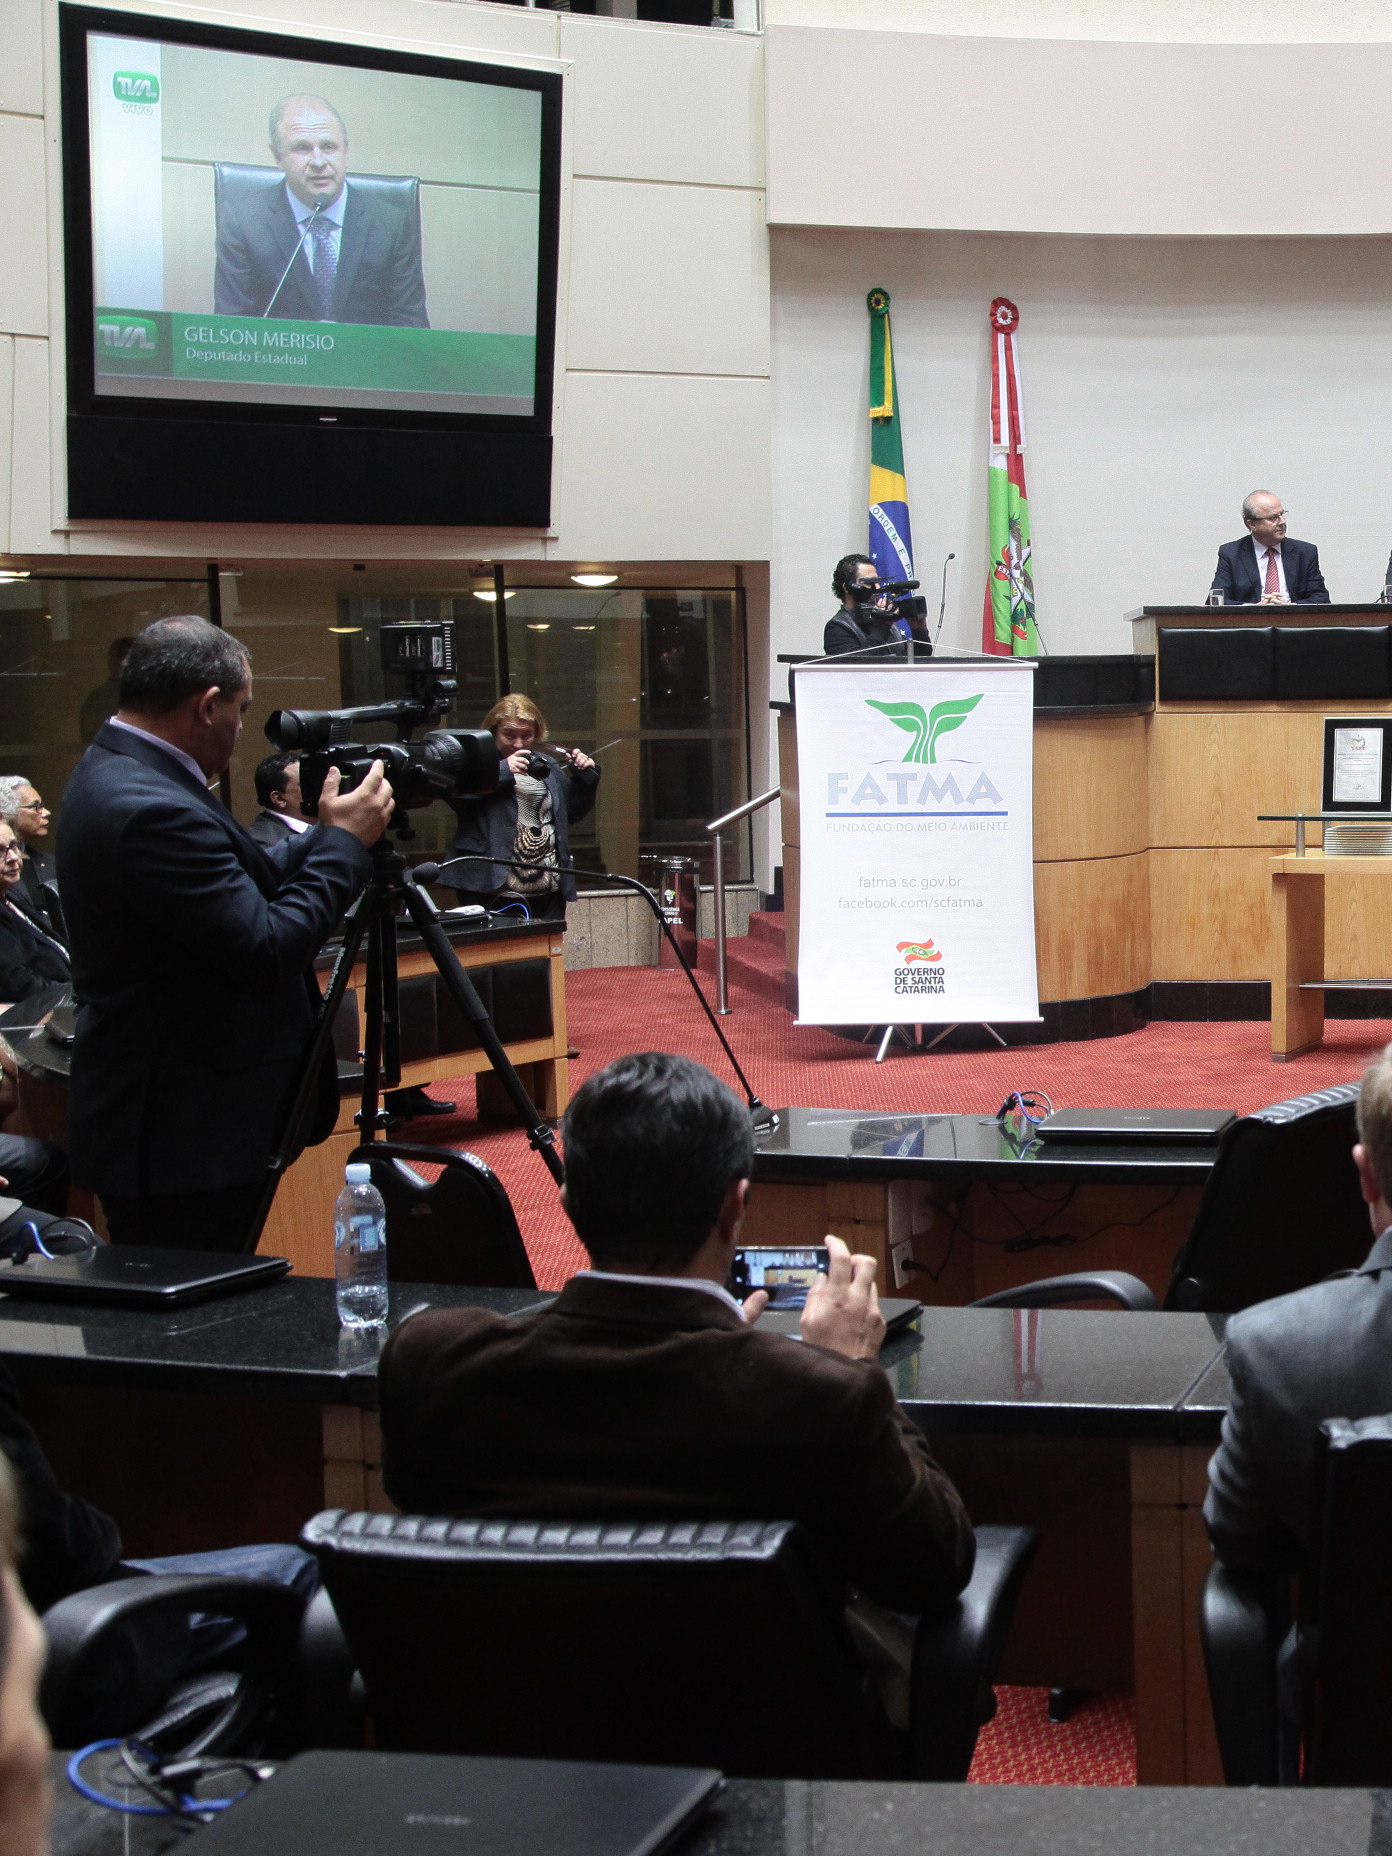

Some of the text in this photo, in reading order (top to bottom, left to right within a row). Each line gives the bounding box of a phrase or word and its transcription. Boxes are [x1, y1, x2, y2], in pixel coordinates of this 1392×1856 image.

[184, 325, 335, 350] GELSON MERISIO
[185, 347, 308, 366] Deputado Estadual
[872, 507, 898, 542] ORDEM
[898, 548, 906, 556] E
[827, 770, 1004, 807] FATMA
[826, 821, 1009, 834] FUNDAÇÃO DO MEIO AMBIENTE
[858, 876, 962, 890] fatma.sc.gov.br
[838, 895, 983, 909] facebook.com/scfatma
[658, 917, 684, 925] PEL
[894, 967, 945, 976] GOVERNO
[894, 976, 945, 985] DE SANTA
[894, 985, 946, 994] CATARINA
